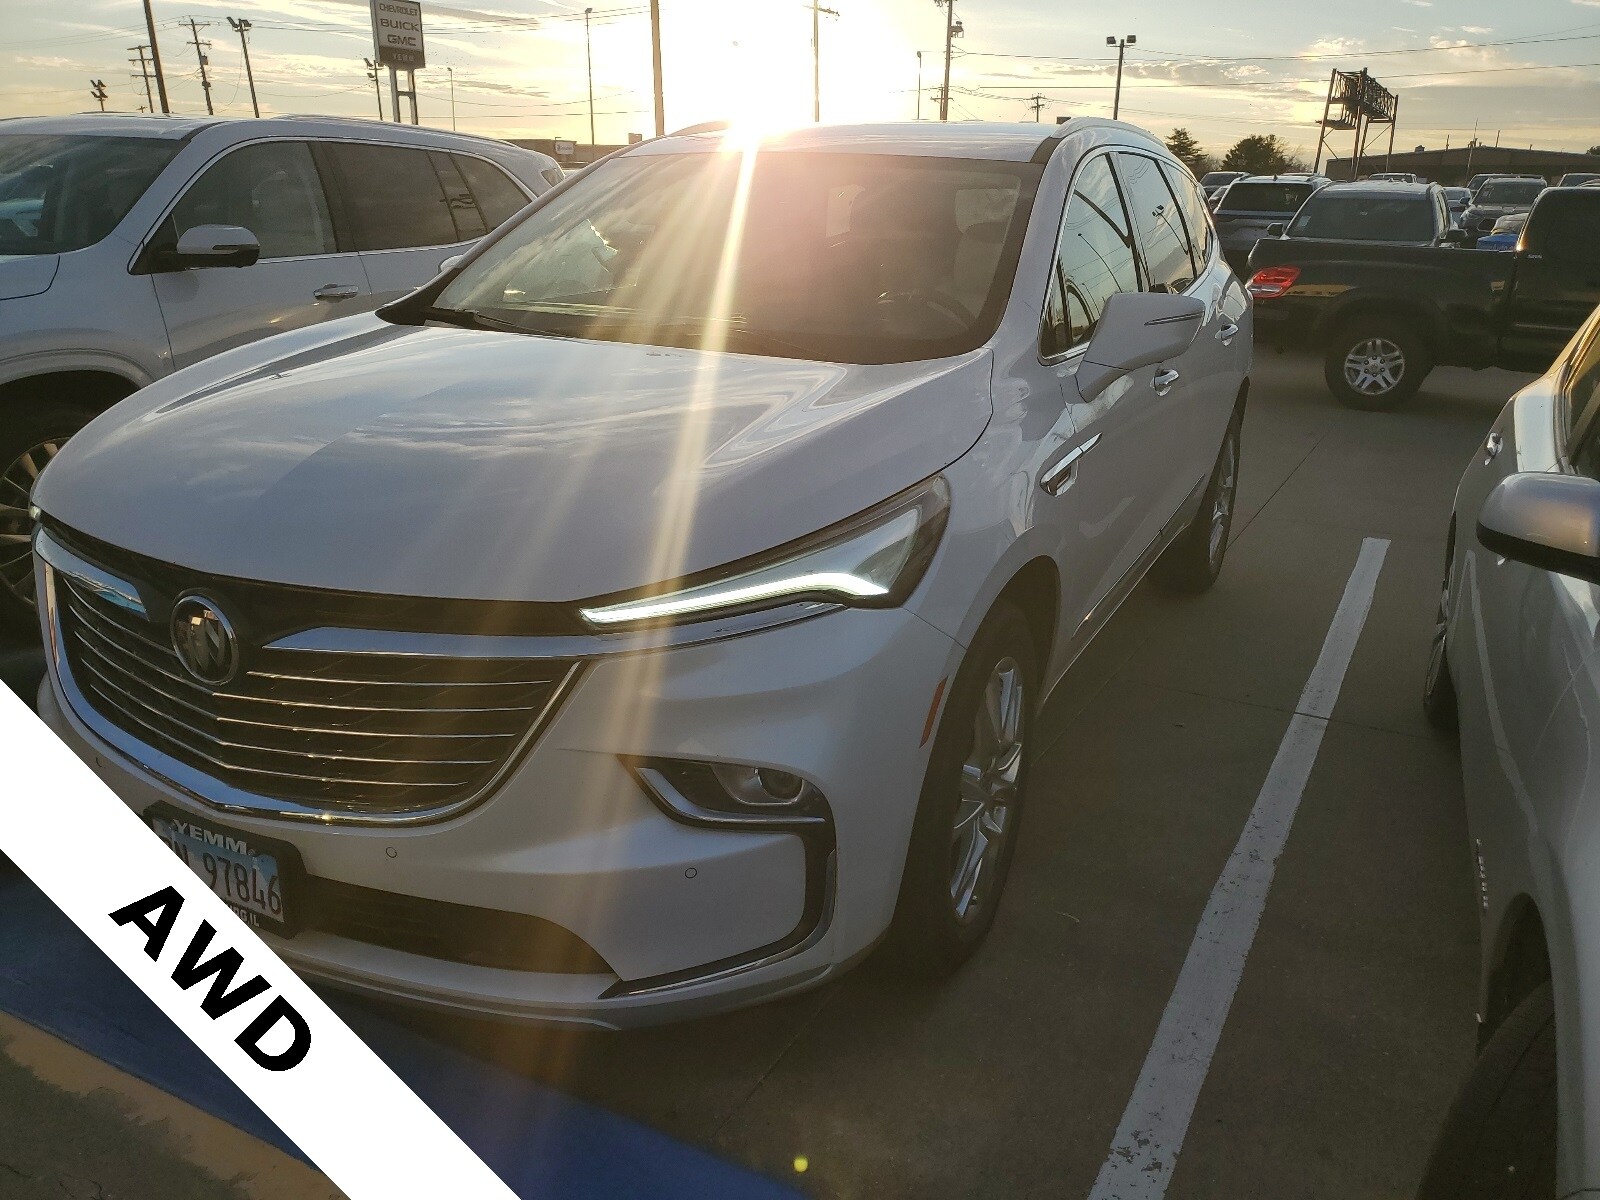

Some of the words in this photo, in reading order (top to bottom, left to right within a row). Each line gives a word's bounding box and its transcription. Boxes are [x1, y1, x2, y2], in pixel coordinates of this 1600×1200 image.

[380, 3, 417, 16] CHEVROLET
[380, 18, 419, 31] BUICK
[387, 34, 416, 46] GMC
[173, 819, 247, 855] YEMM
[203, 852, 282, 915] 97846
